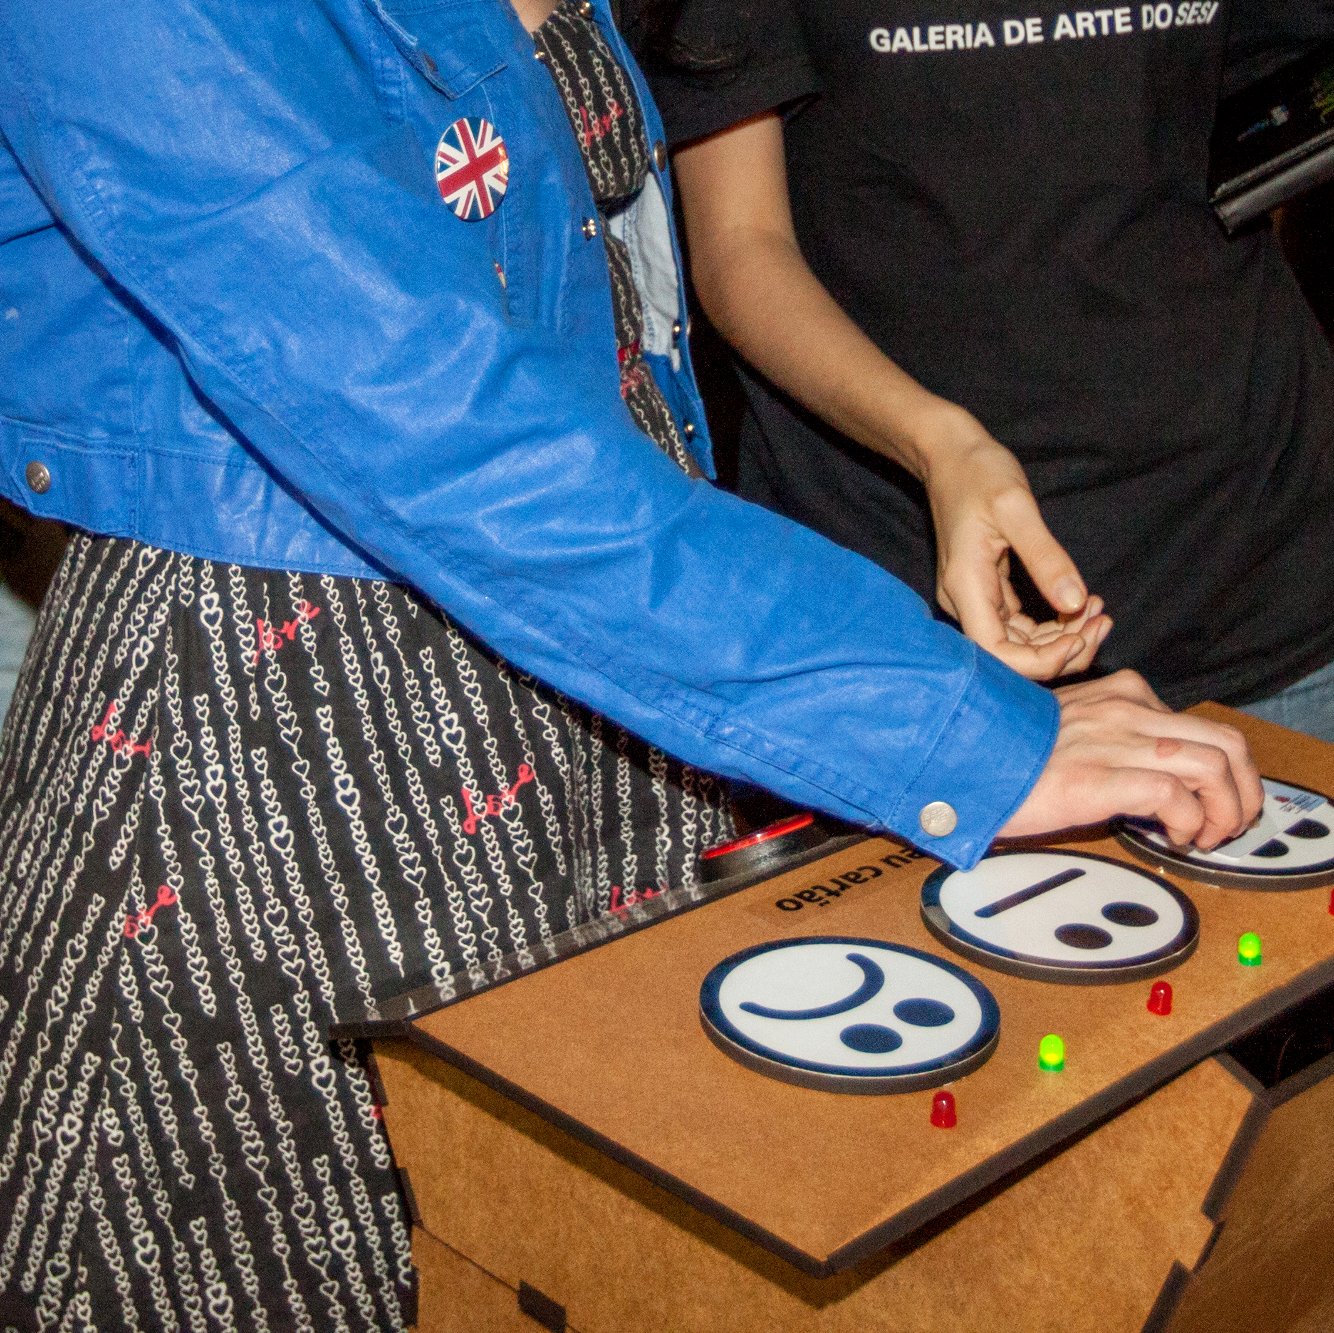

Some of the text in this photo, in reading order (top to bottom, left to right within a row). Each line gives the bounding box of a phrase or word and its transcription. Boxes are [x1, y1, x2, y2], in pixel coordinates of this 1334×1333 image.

[870, 1, 1218, 53] GALERIA DE ARTE DO SESI
[775, 866, 883, 911] cartão
